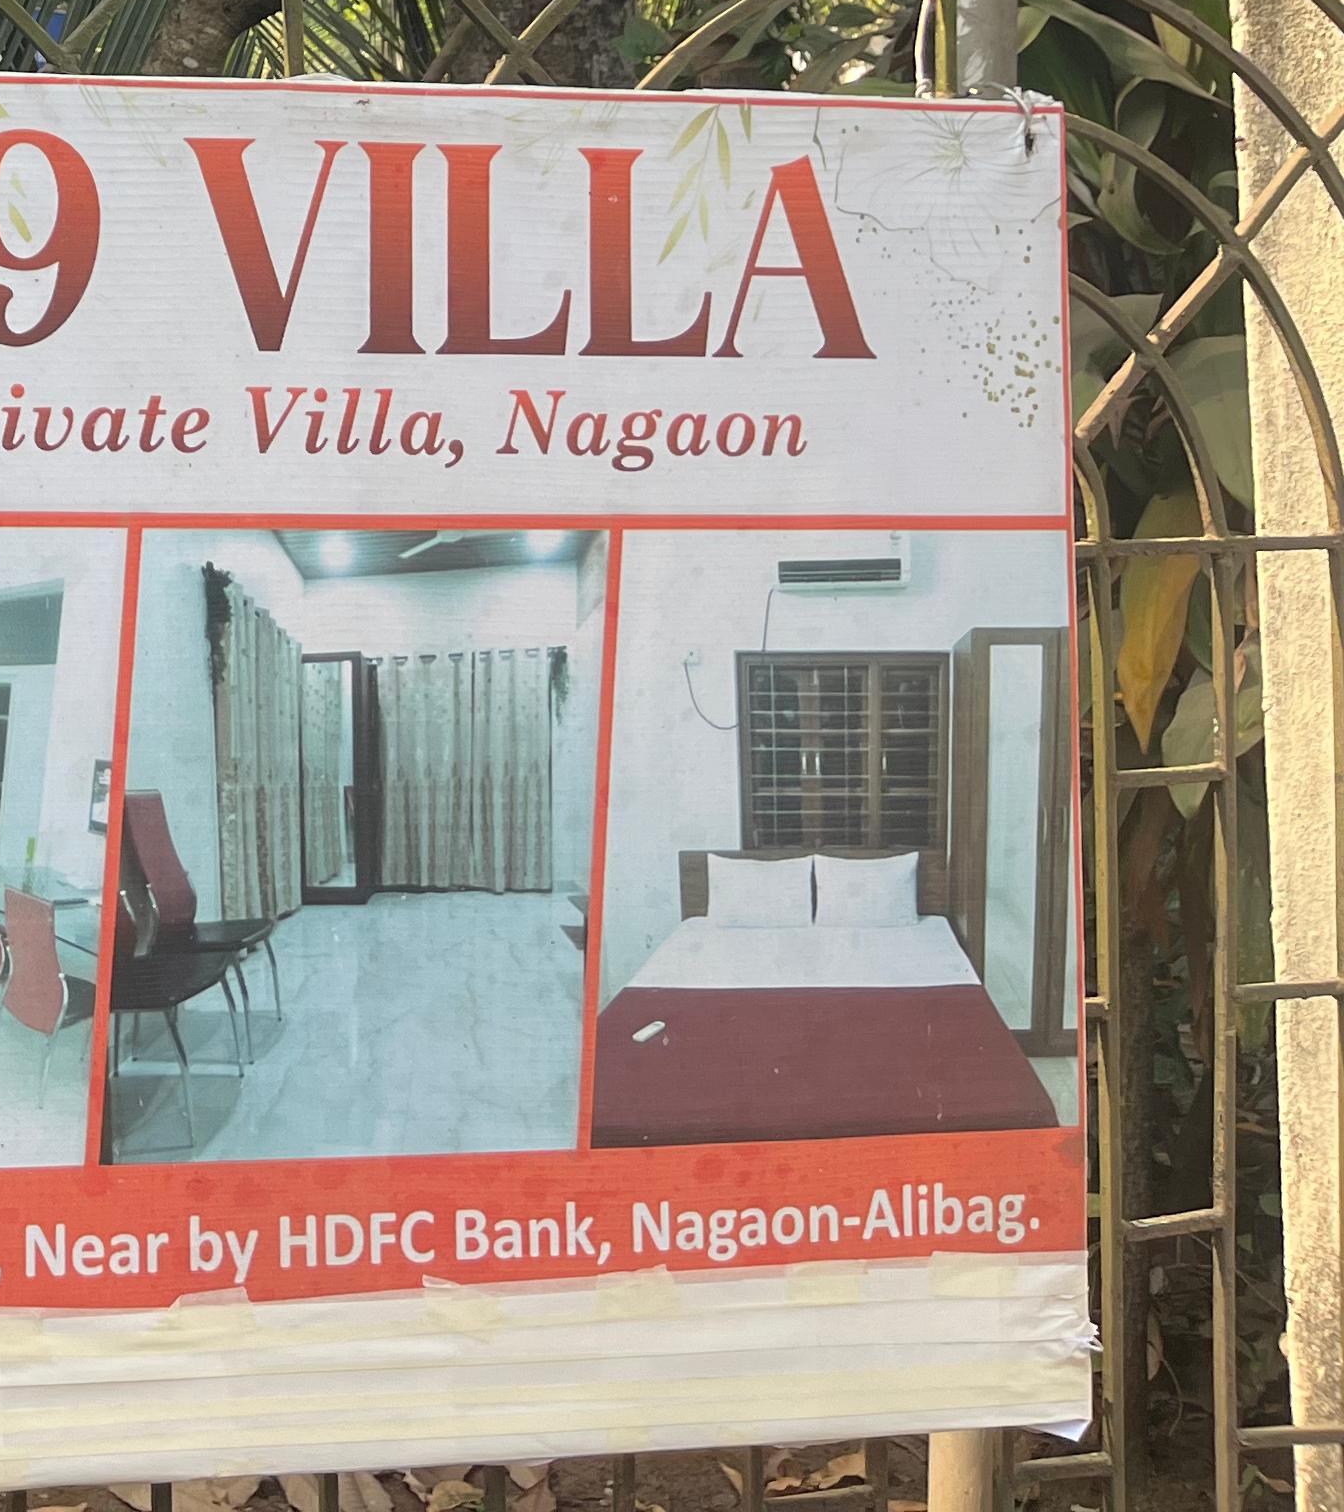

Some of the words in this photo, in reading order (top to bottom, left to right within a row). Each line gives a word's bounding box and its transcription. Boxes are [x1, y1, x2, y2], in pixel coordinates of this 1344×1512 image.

[184, 137, 874, 360] VILLA
[242, 386, 467, 467] Villa,
[495, 388, 808, 474] Nagaon
[24, 1222, 170, 1279] Near
[188, 1214, 260, 1285] by
[278, 1209, 436, 1269] HDFC
[454, 1200, 612, 1266] Bank,
[631, 1181, 1042, 1263] Nagaon-Alibag.
